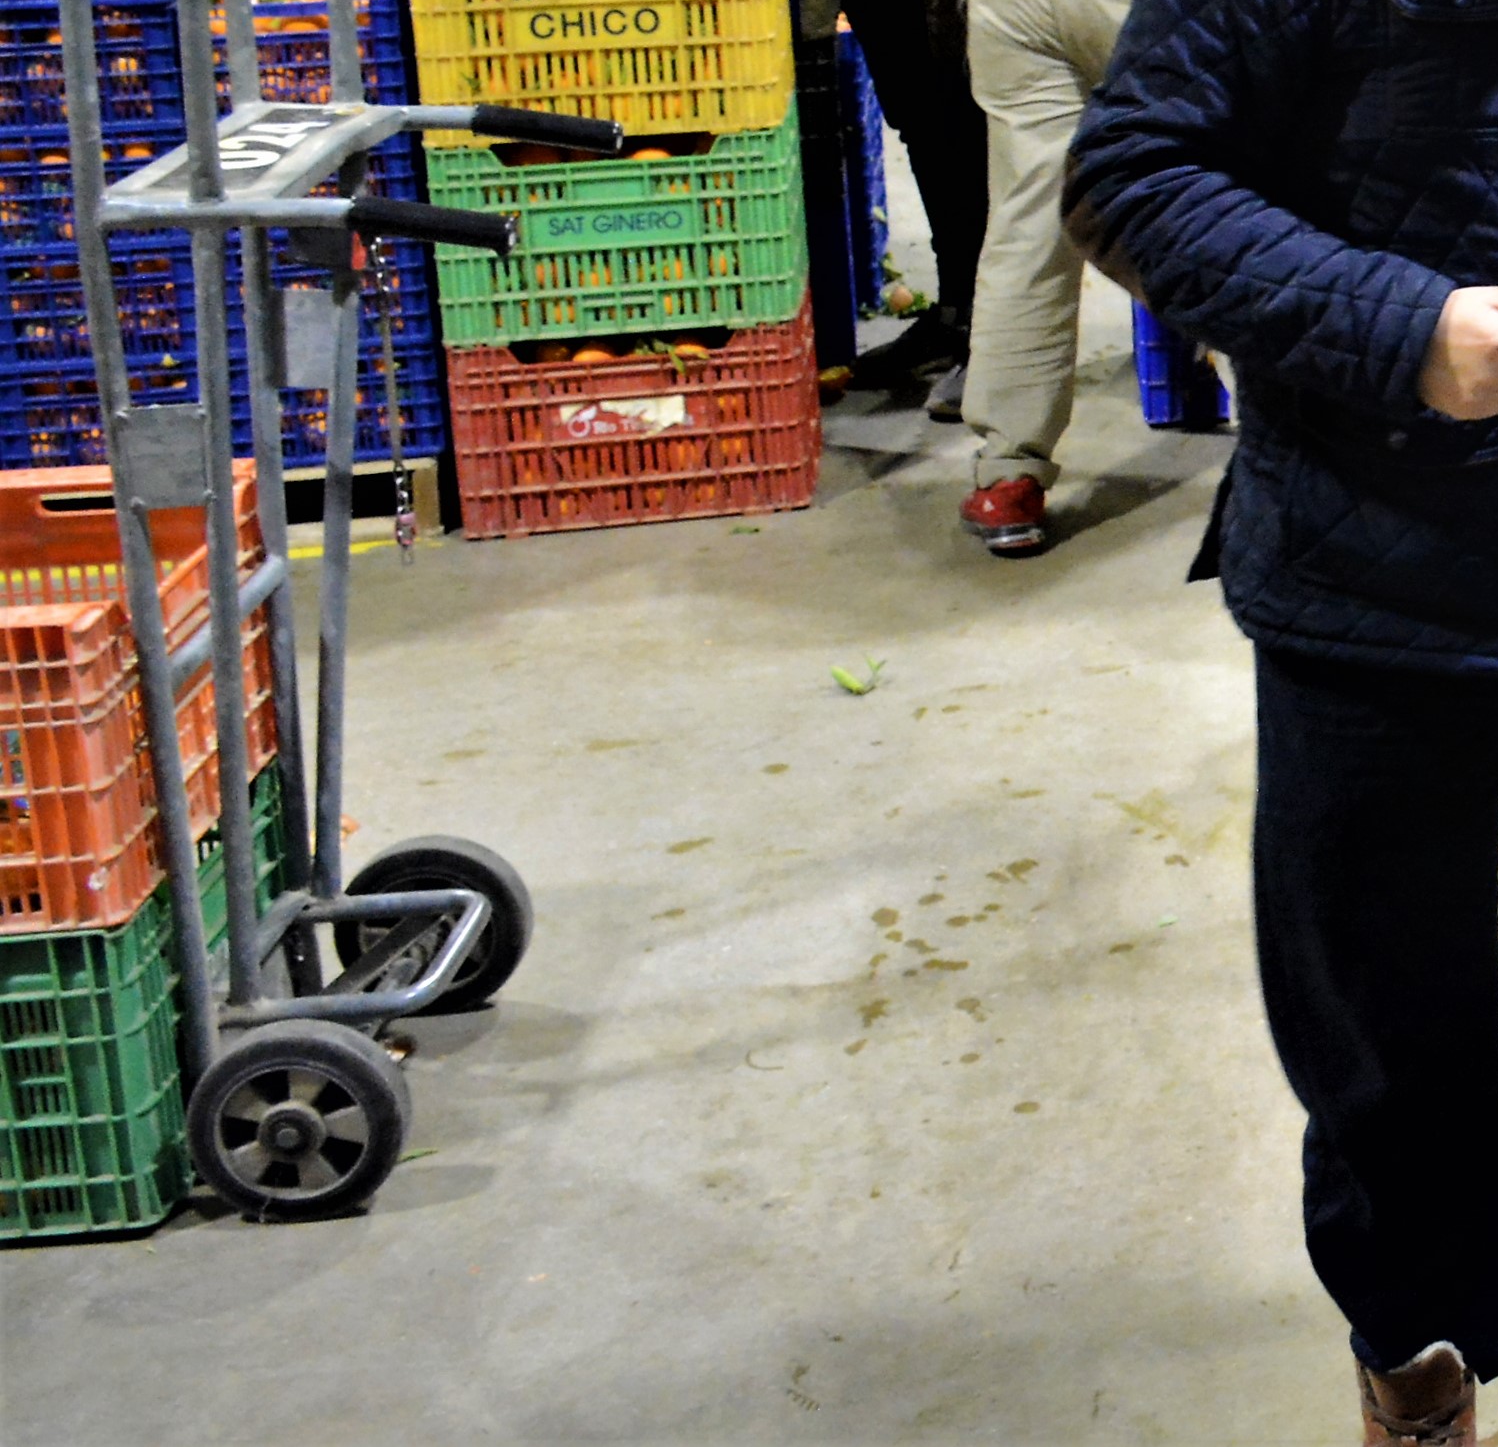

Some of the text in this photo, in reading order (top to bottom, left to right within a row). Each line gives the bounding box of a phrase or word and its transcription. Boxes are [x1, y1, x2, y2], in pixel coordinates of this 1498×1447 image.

[530, 8, 660, 39] CHICO
[549, 210, 683, 237] SAT GINERO
